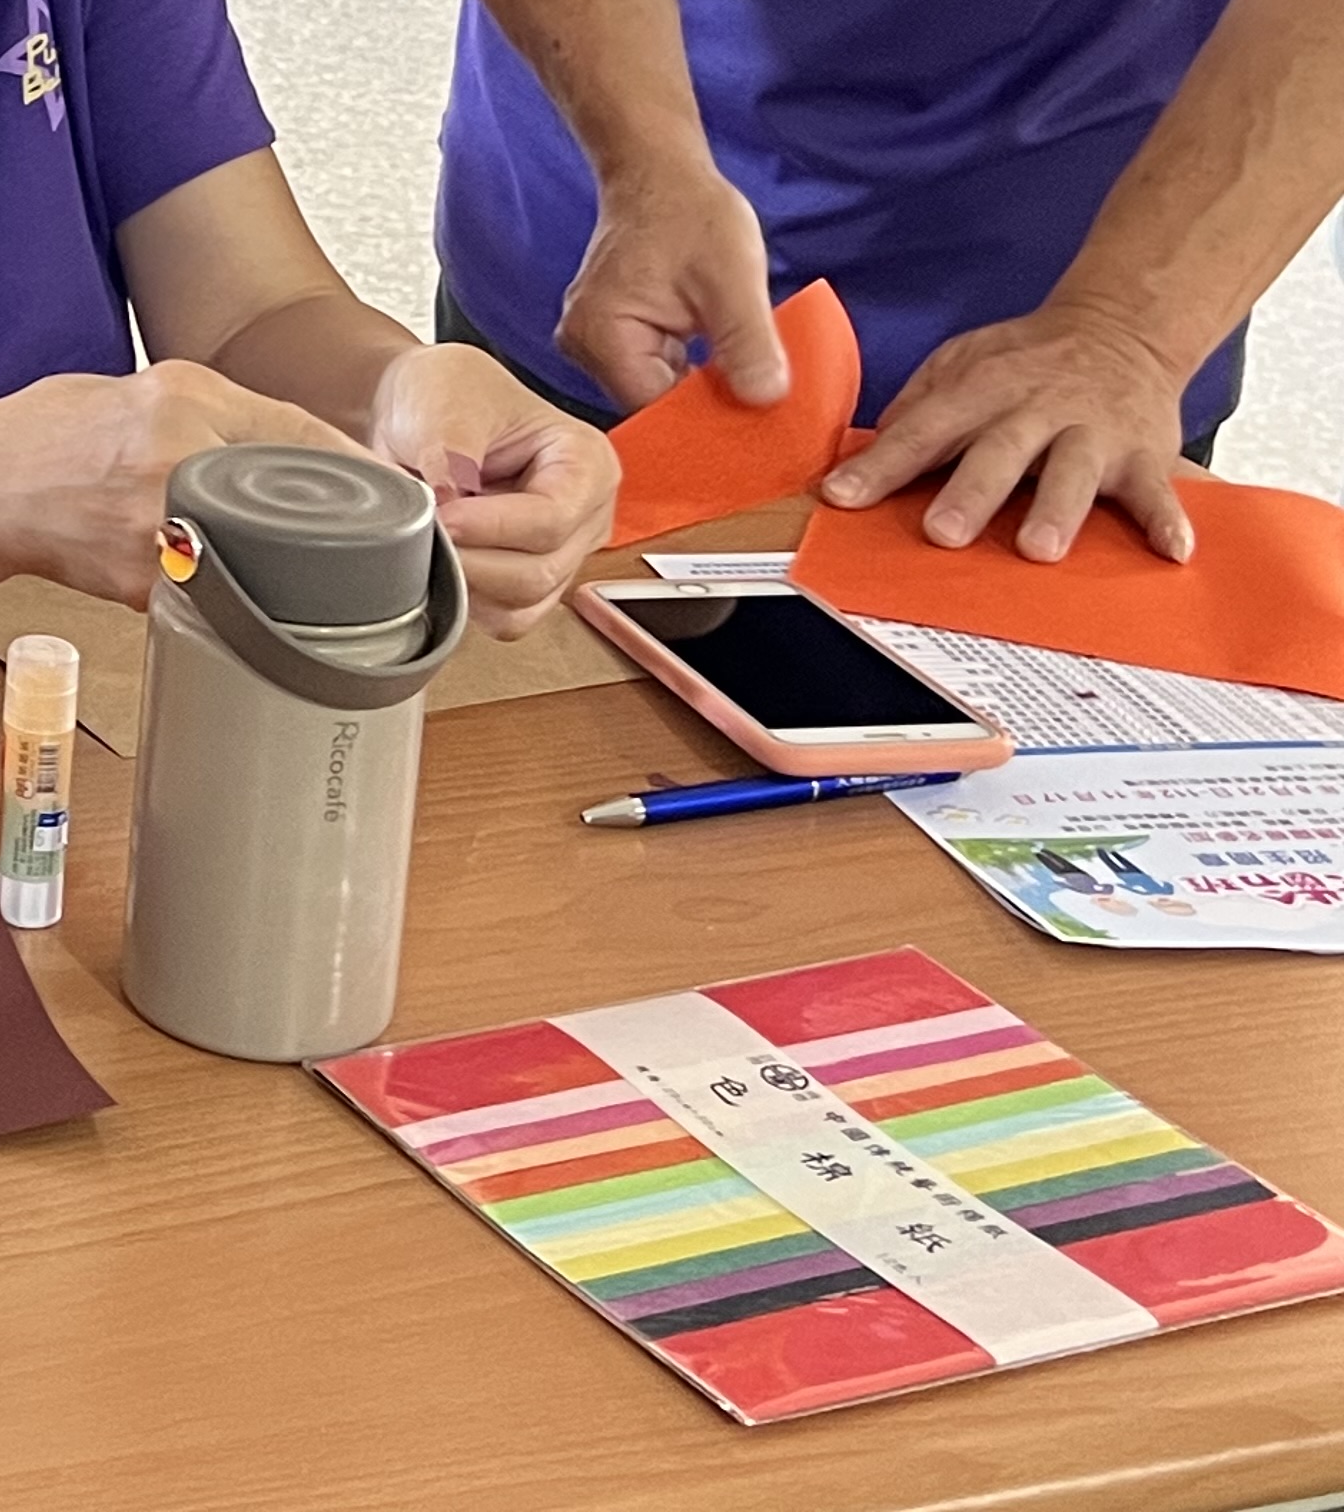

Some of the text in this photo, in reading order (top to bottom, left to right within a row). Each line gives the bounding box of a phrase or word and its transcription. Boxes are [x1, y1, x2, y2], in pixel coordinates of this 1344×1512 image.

[1192, 849, 1332, 869] 招生簡章
[1183, 872, 1344, 909] 齡班
